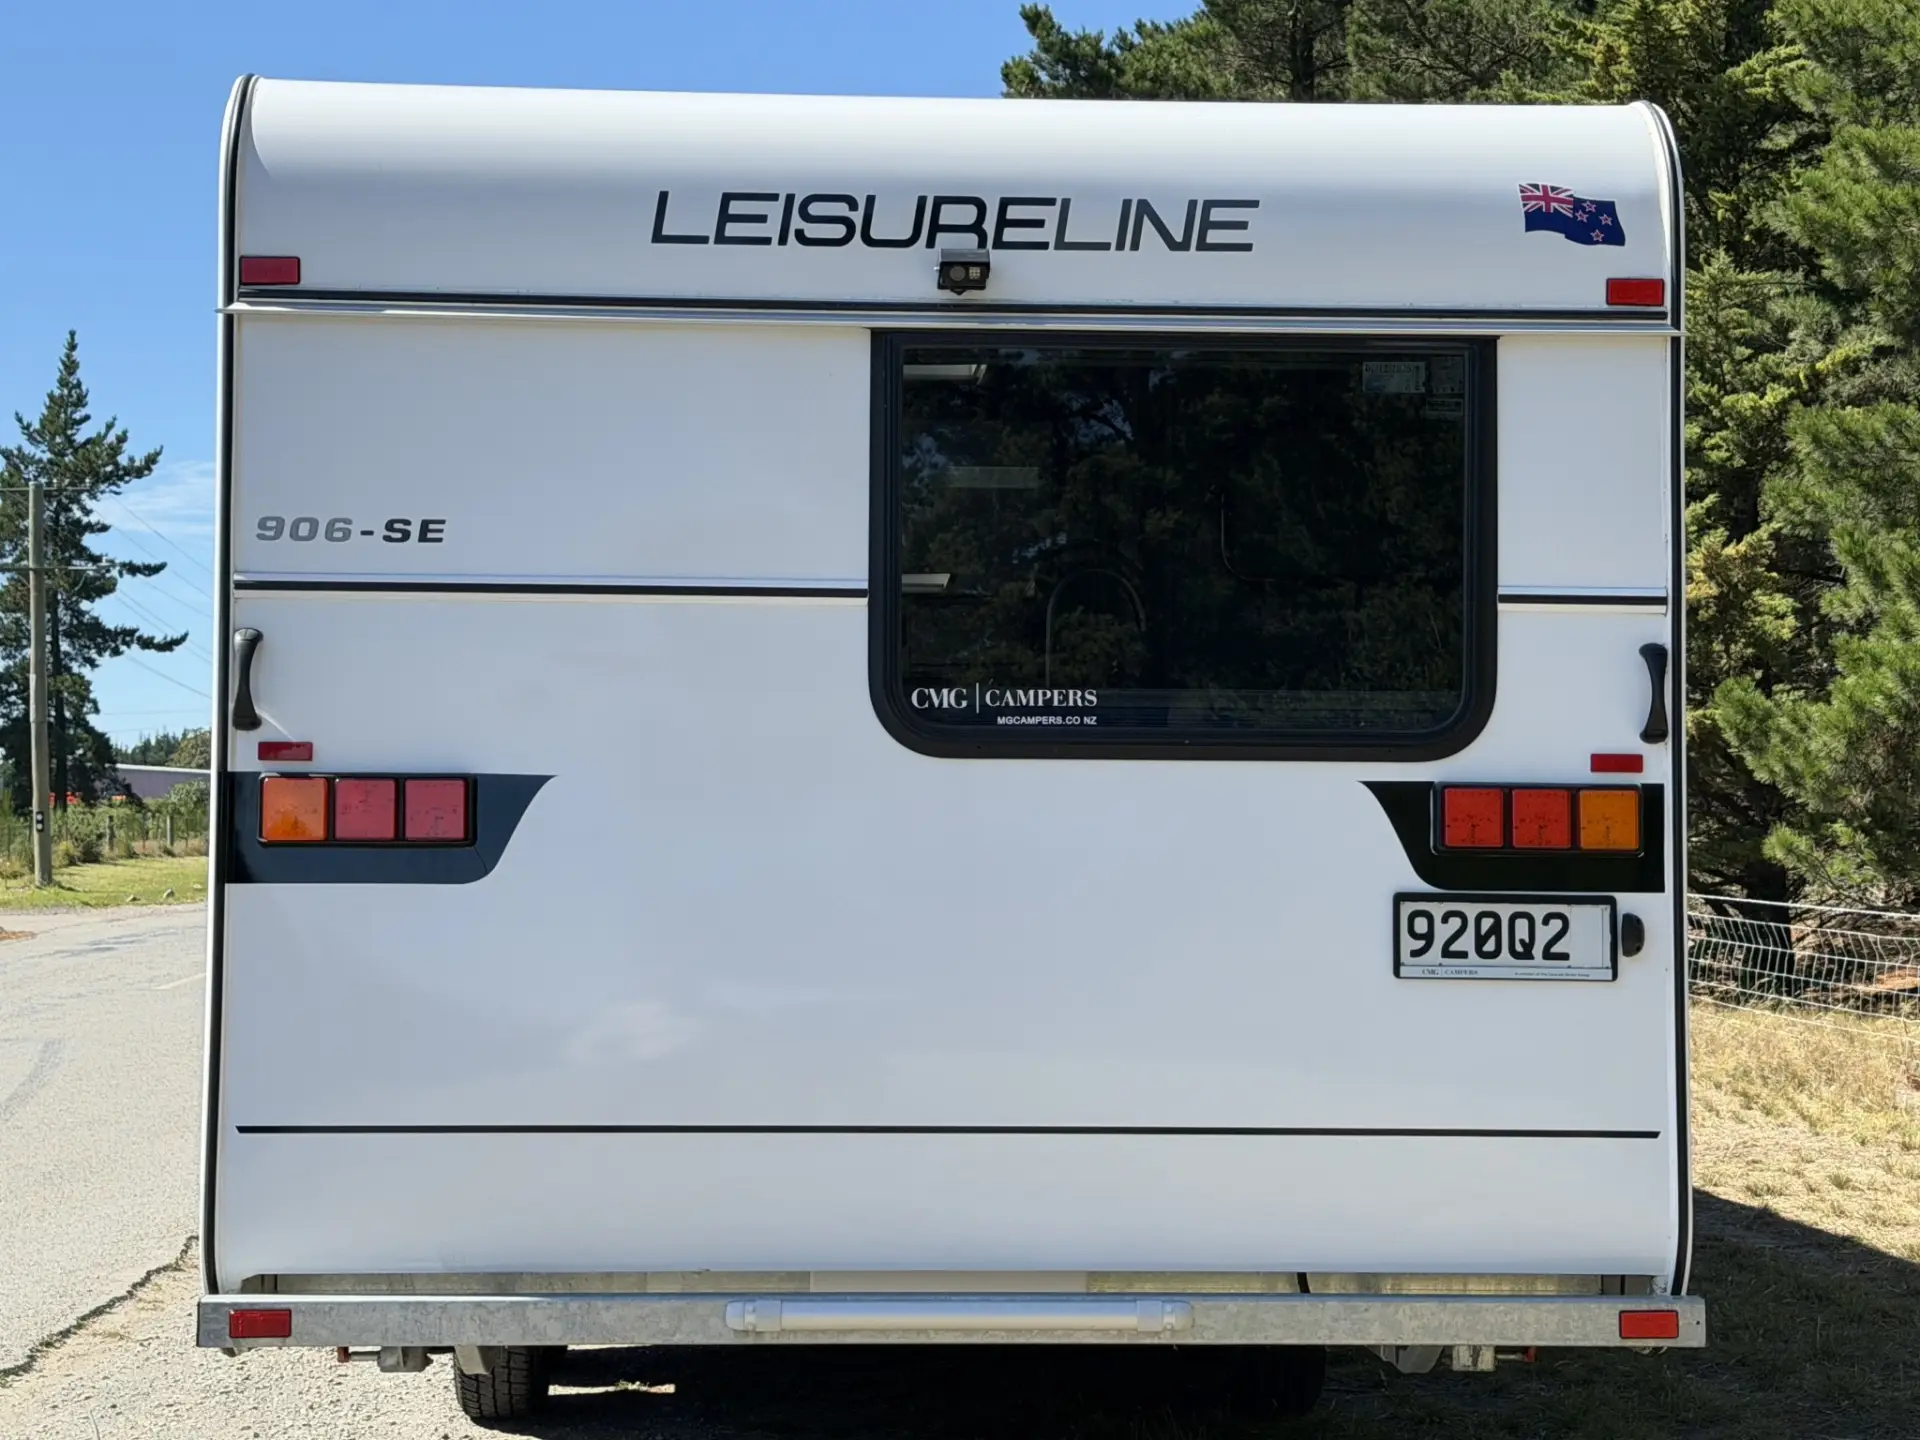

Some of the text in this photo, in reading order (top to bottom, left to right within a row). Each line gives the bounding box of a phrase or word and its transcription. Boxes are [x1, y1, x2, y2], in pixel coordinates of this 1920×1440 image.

[651, 190, 1260, 253] LEISURELINE
[256, 516, 447, 544] 906-SE
[911, 688, 1099, 709] CMG CAMPERS
[1407, 909, 1570, 961] 920Q2
